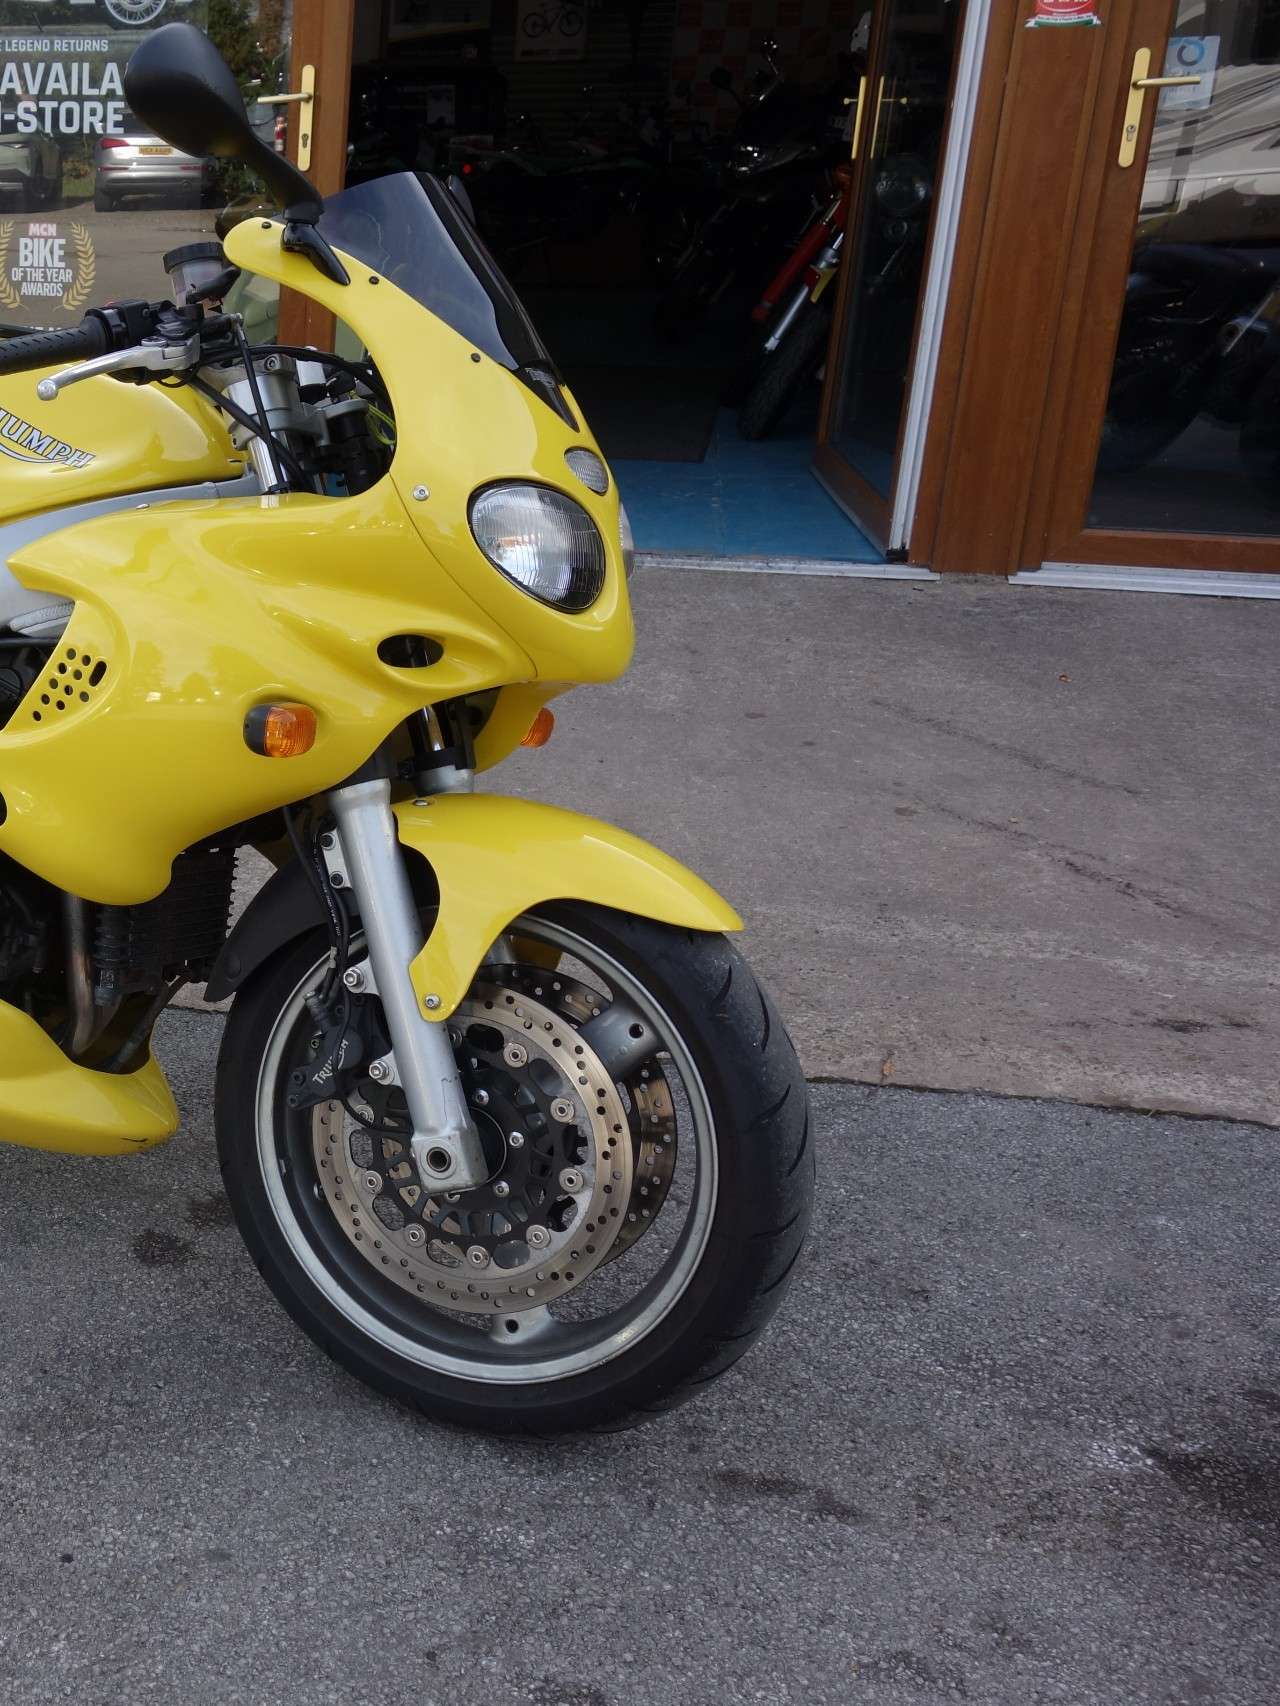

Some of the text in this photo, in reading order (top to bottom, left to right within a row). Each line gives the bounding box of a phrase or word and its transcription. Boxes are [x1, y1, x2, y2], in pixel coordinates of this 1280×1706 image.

[5, 40, 50, 52] LEGEND
[54, 40, 109, 52] RETURNS
[0, 62, 128, 96] AVAILA
[28, 223, 57, 236] MCN
[19, 237, 66, 268] BIKE
[11, 267, 73, 283] OF THE YEAR
[21, 282, 64, 297] AWARDS
